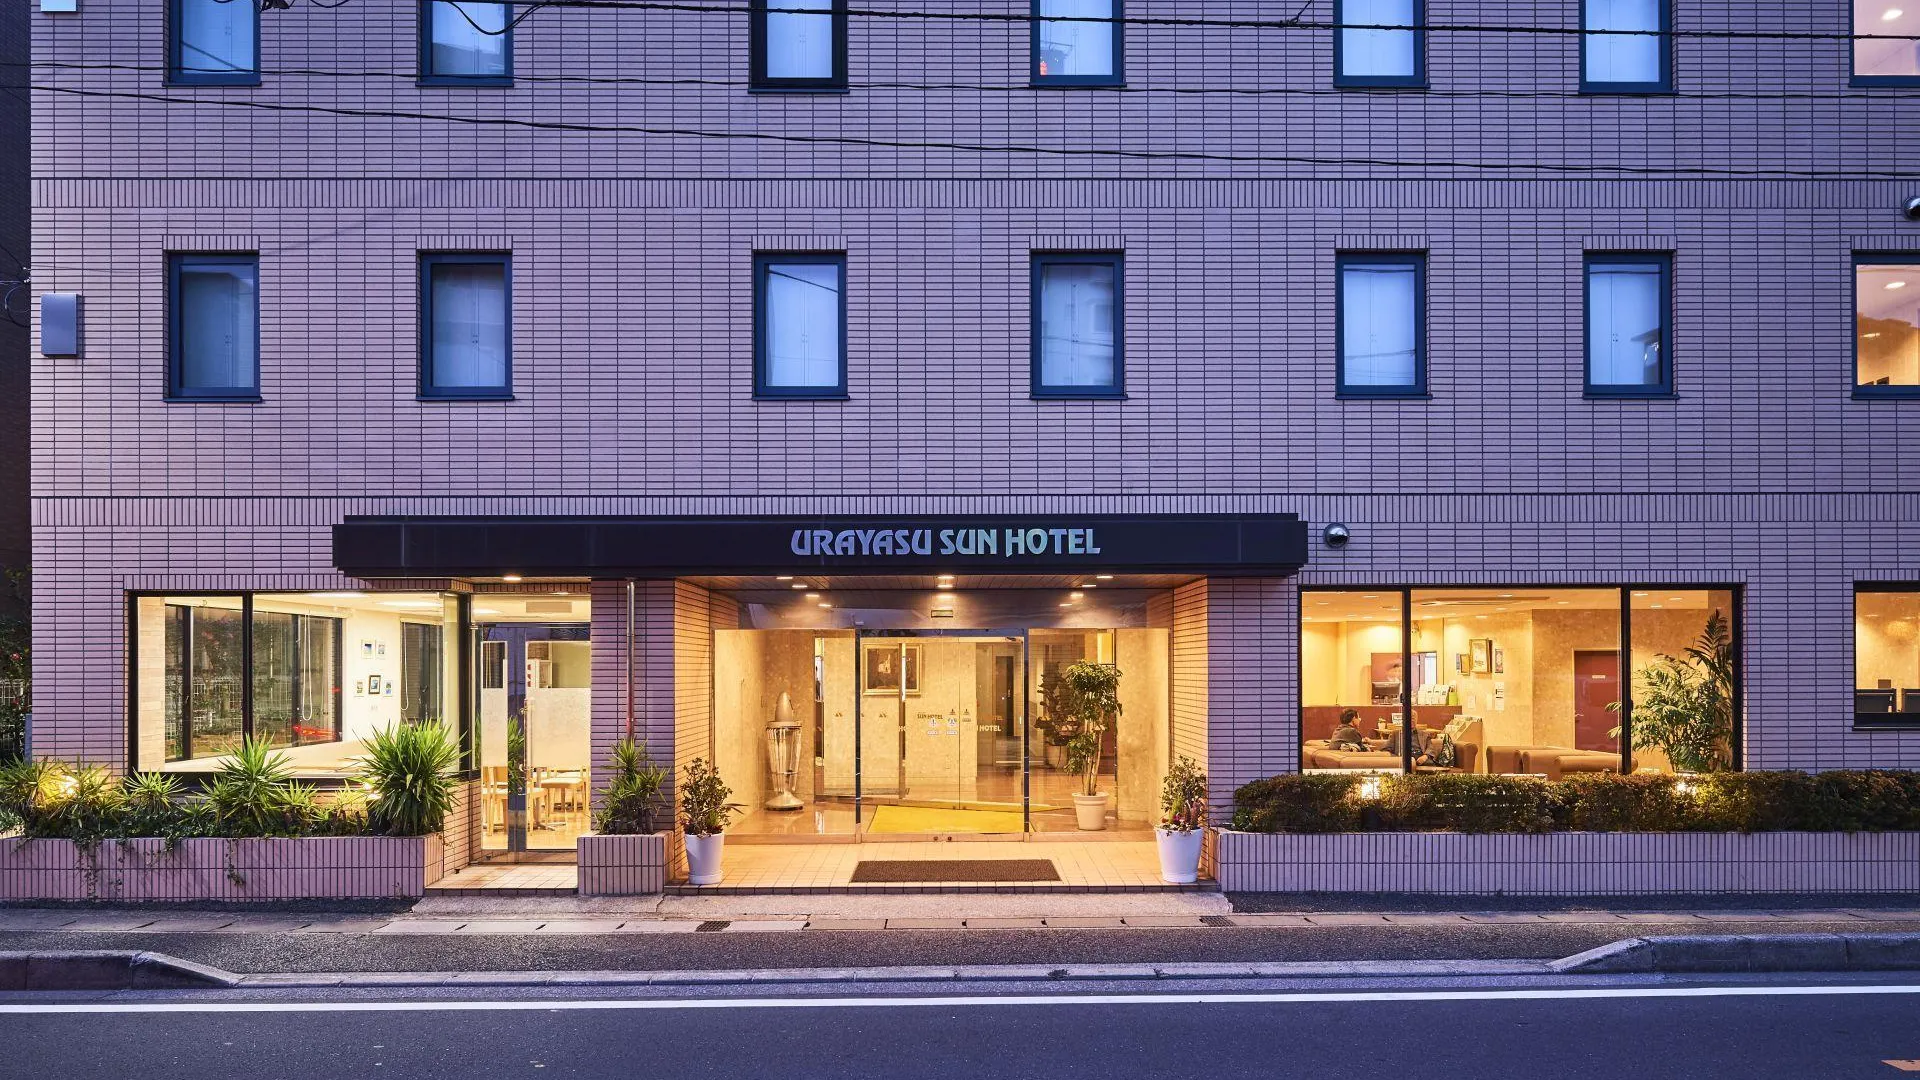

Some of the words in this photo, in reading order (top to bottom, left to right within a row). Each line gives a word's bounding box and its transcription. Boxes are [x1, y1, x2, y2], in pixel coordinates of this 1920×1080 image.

[790, 529, 932, 556] URAYASU
[939, 529, 997, 555] SUN
[1005, 528, 1101, 558] HOTEL
